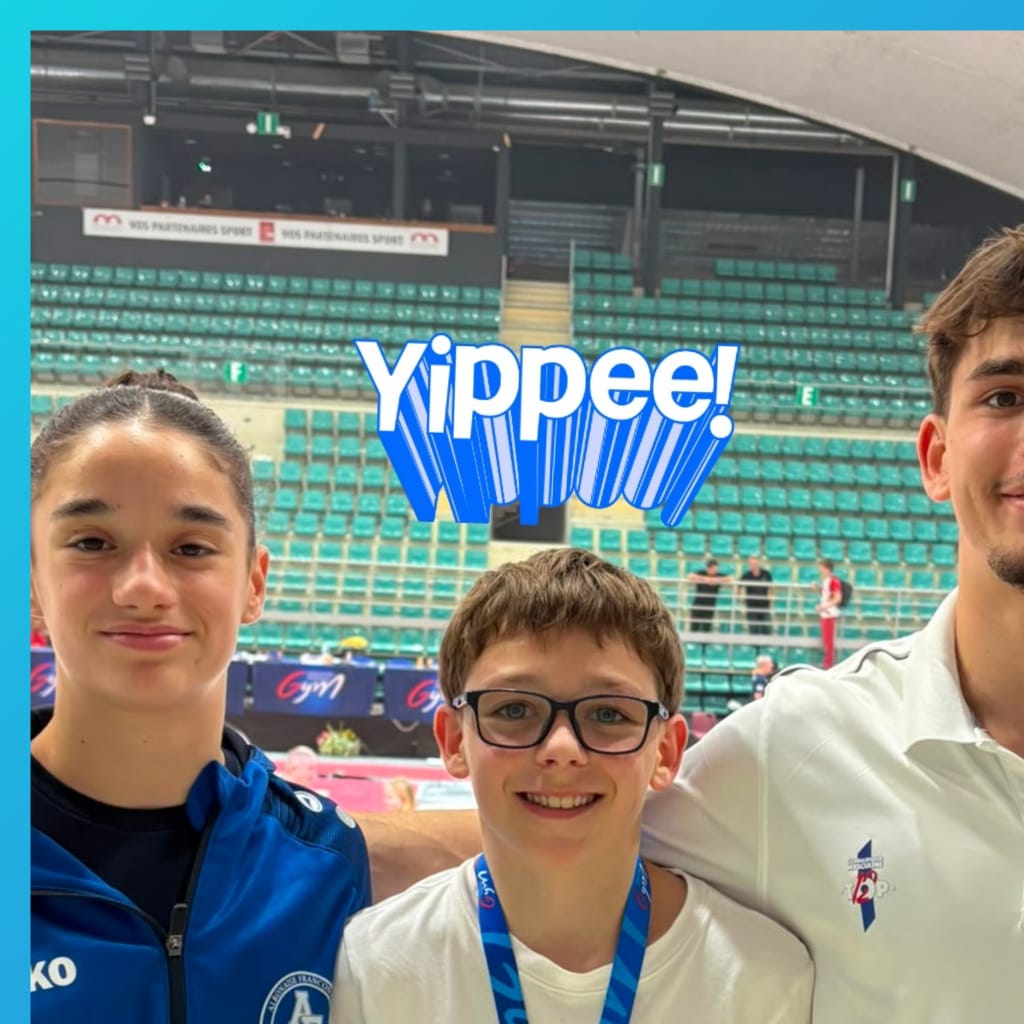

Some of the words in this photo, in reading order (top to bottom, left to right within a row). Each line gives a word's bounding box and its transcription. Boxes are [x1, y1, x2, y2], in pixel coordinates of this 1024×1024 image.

[129, 219, 149, 231] VOS
[220, 225, 253, 237] SPORT
[30, 956, 77, 993] KO
